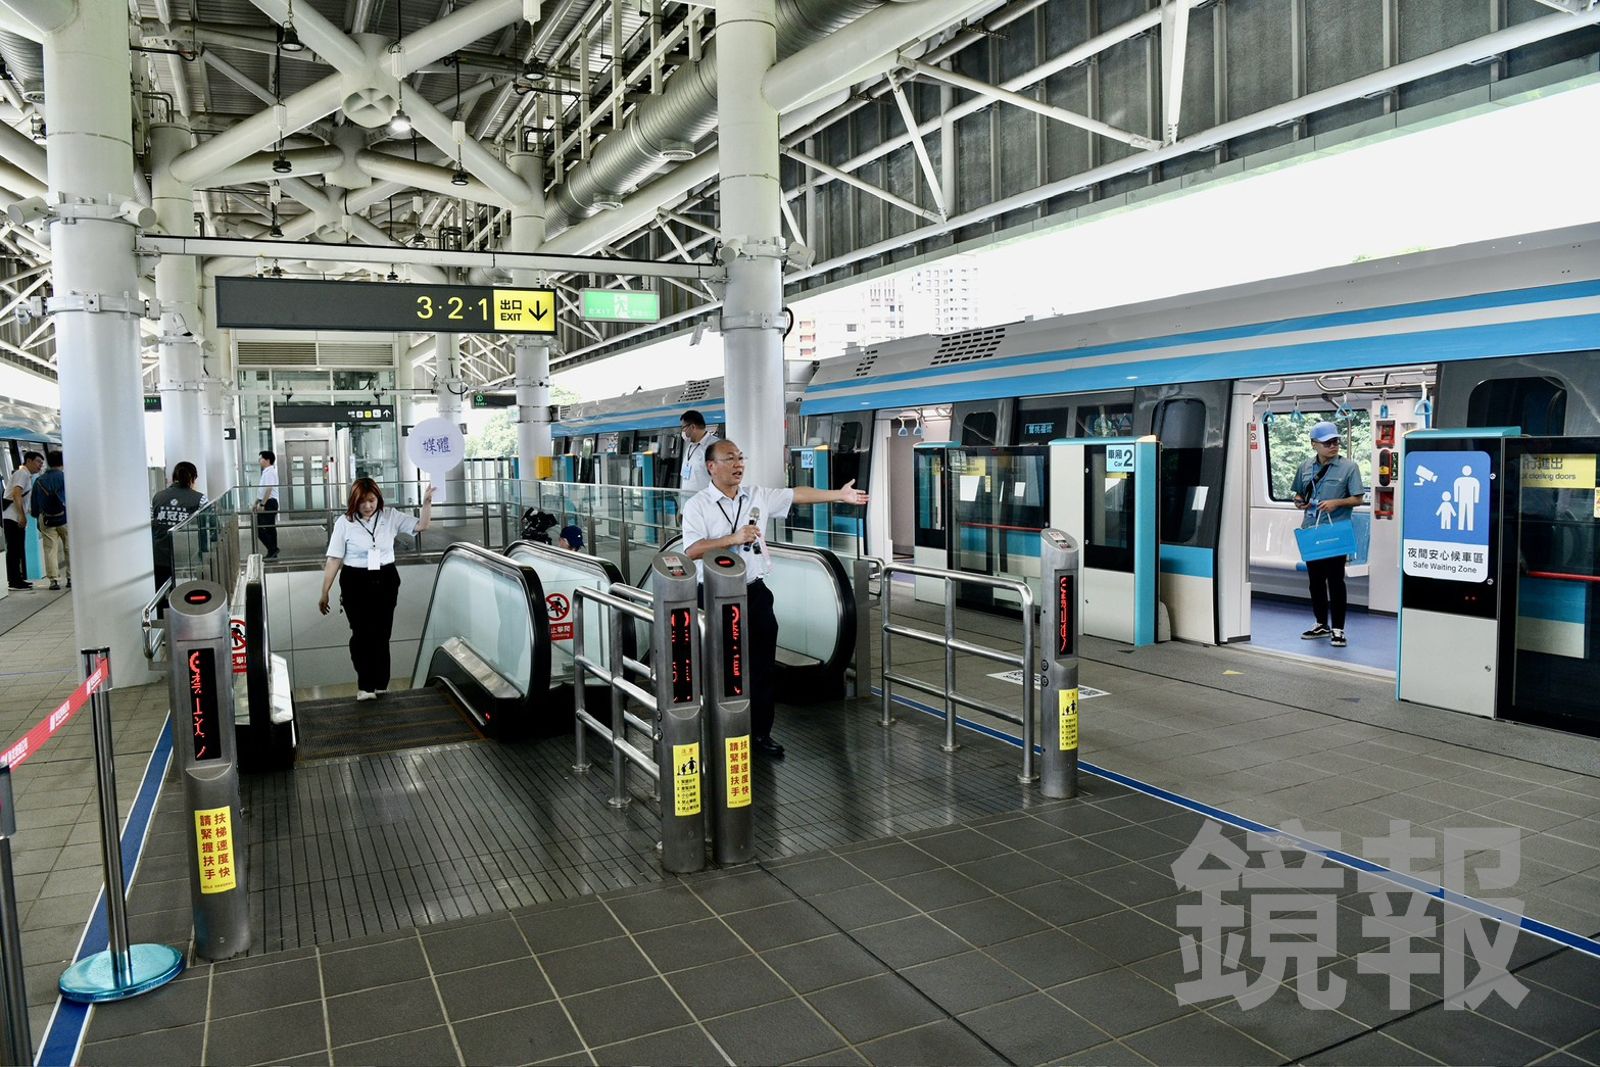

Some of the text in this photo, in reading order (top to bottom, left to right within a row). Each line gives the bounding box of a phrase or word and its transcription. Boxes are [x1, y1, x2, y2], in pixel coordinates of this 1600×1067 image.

[500, 299, 522, 310] 出口
[500, 313, 522, 322] EXIT
[422, 436, 451, 455] 媒體
[1123, 449, 1133, 467] 2
[1407, 547, 1484, 564] 夜間安心候車區
[1412, 561, 1477, 574] Safe Waiting Zone
[729, 742, 740, 797] 請緊握扶手
[199, 815, 216, 880] 請緊握扶手
[214, 812, 231, 878] 扶梯速度快
